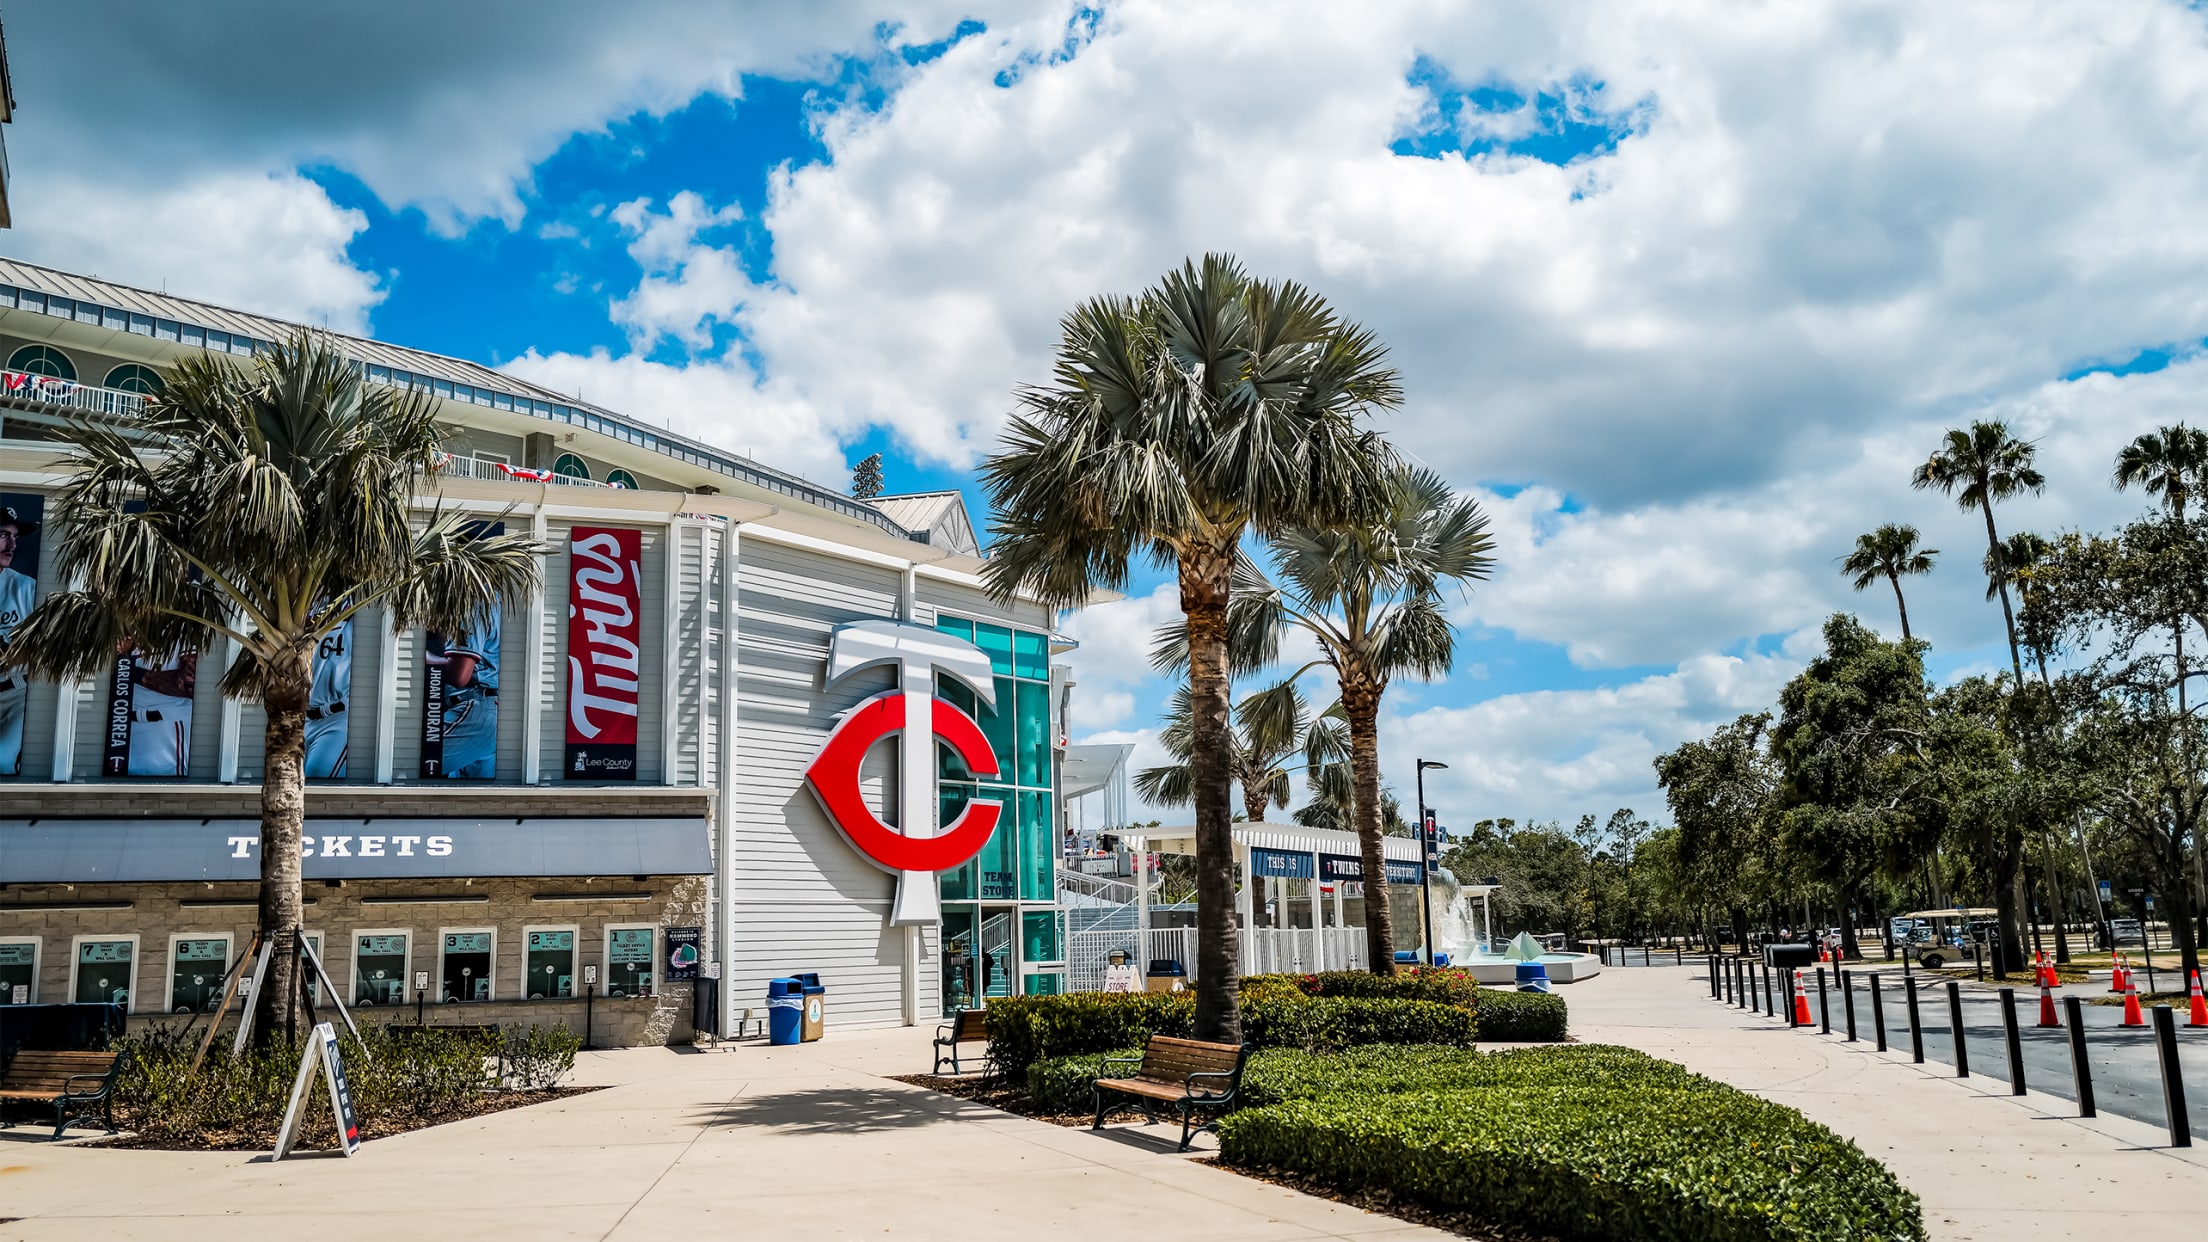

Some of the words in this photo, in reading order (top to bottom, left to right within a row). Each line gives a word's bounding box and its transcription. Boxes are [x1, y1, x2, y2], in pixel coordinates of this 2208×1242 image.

[570, 533, 638, 739] Twins
[320, 633, 345, 660] 64
[116, 658, 131, 696] CARLOS
[429, 667, 442, 699] JHOAN
[110, 699, 129, 748] CORREA
[426, 702, 441, 742] DURAN
[585, 758, 602, 767] Lee
[602, 757, 632, 768] County
[227, 835, 454, 858] TCKETS
[1267, 856, 1285, 869] THIS
[1289, 857, 1297, 870] IS
[1333, 860, 1360, 876] TWINS
[984, 871, 1013, 882] TEAM
[982, 885, 1014, 896] STORE
[448, 936, 457, 947] 3
[531, 934, 540, 945] 2
[612, 932, 619, 942] 1
[179, 943, 190, 954] 6
[361, 938, 371, 949] 4
[83, 945, 94, 956] 7
[1108, 982, 1128, 991] STORE
